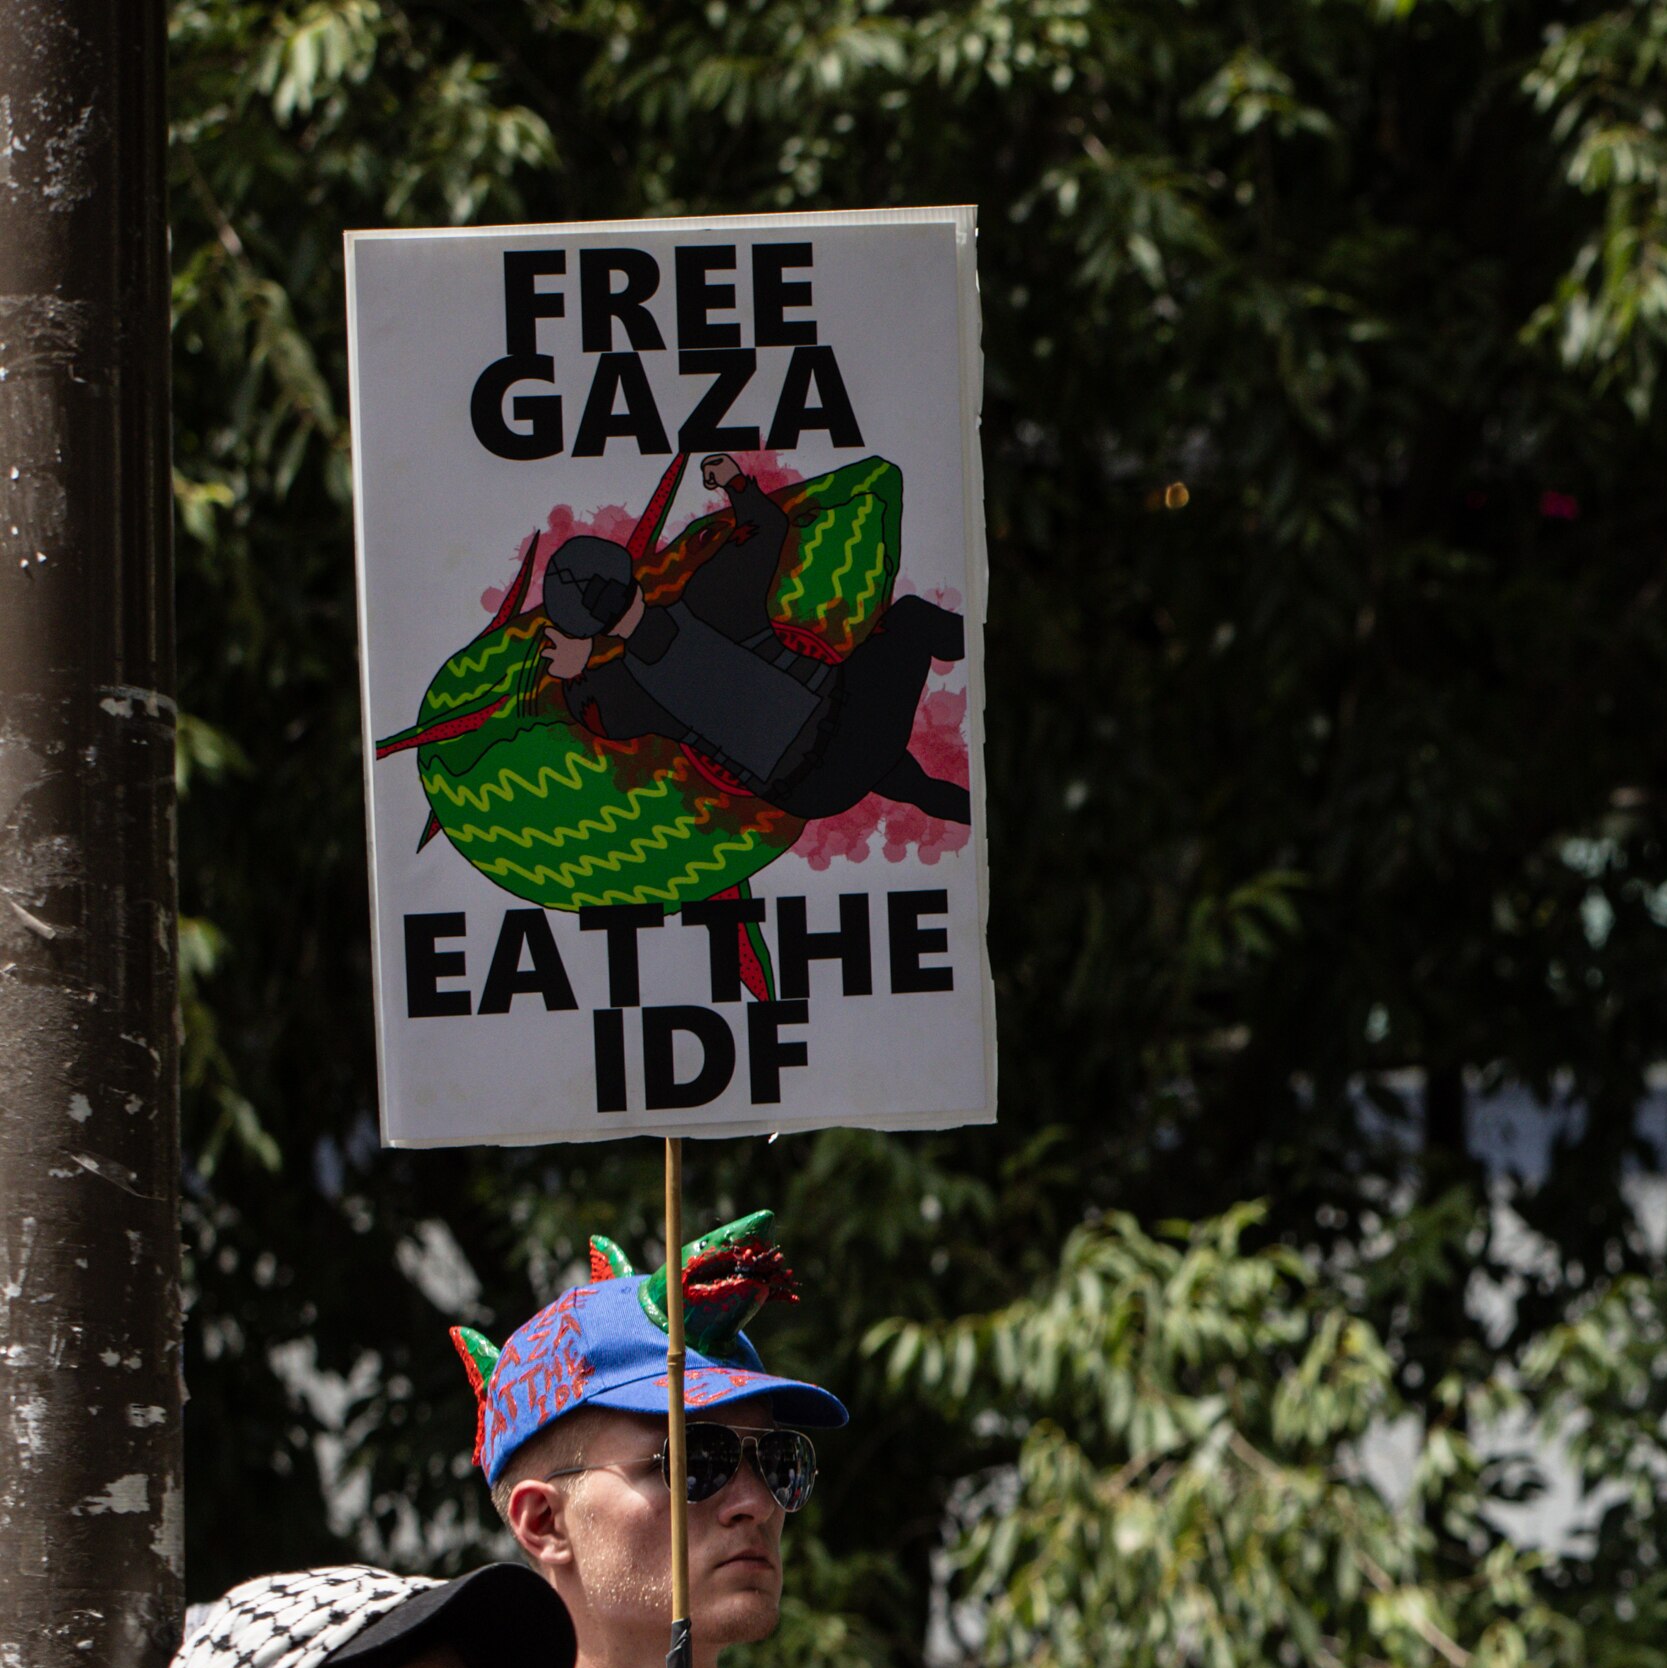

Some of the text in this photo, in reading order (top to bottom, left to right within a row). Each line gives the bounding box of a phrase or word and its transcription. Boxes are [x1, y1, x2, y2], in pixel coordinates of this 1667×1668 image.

[503, 242, 818, 354] FREE
[470, 345, 864, 460] GAZA
[403, 889, 953, 1018] EAT THE
[593, 1000, 809, 1113] IDF
